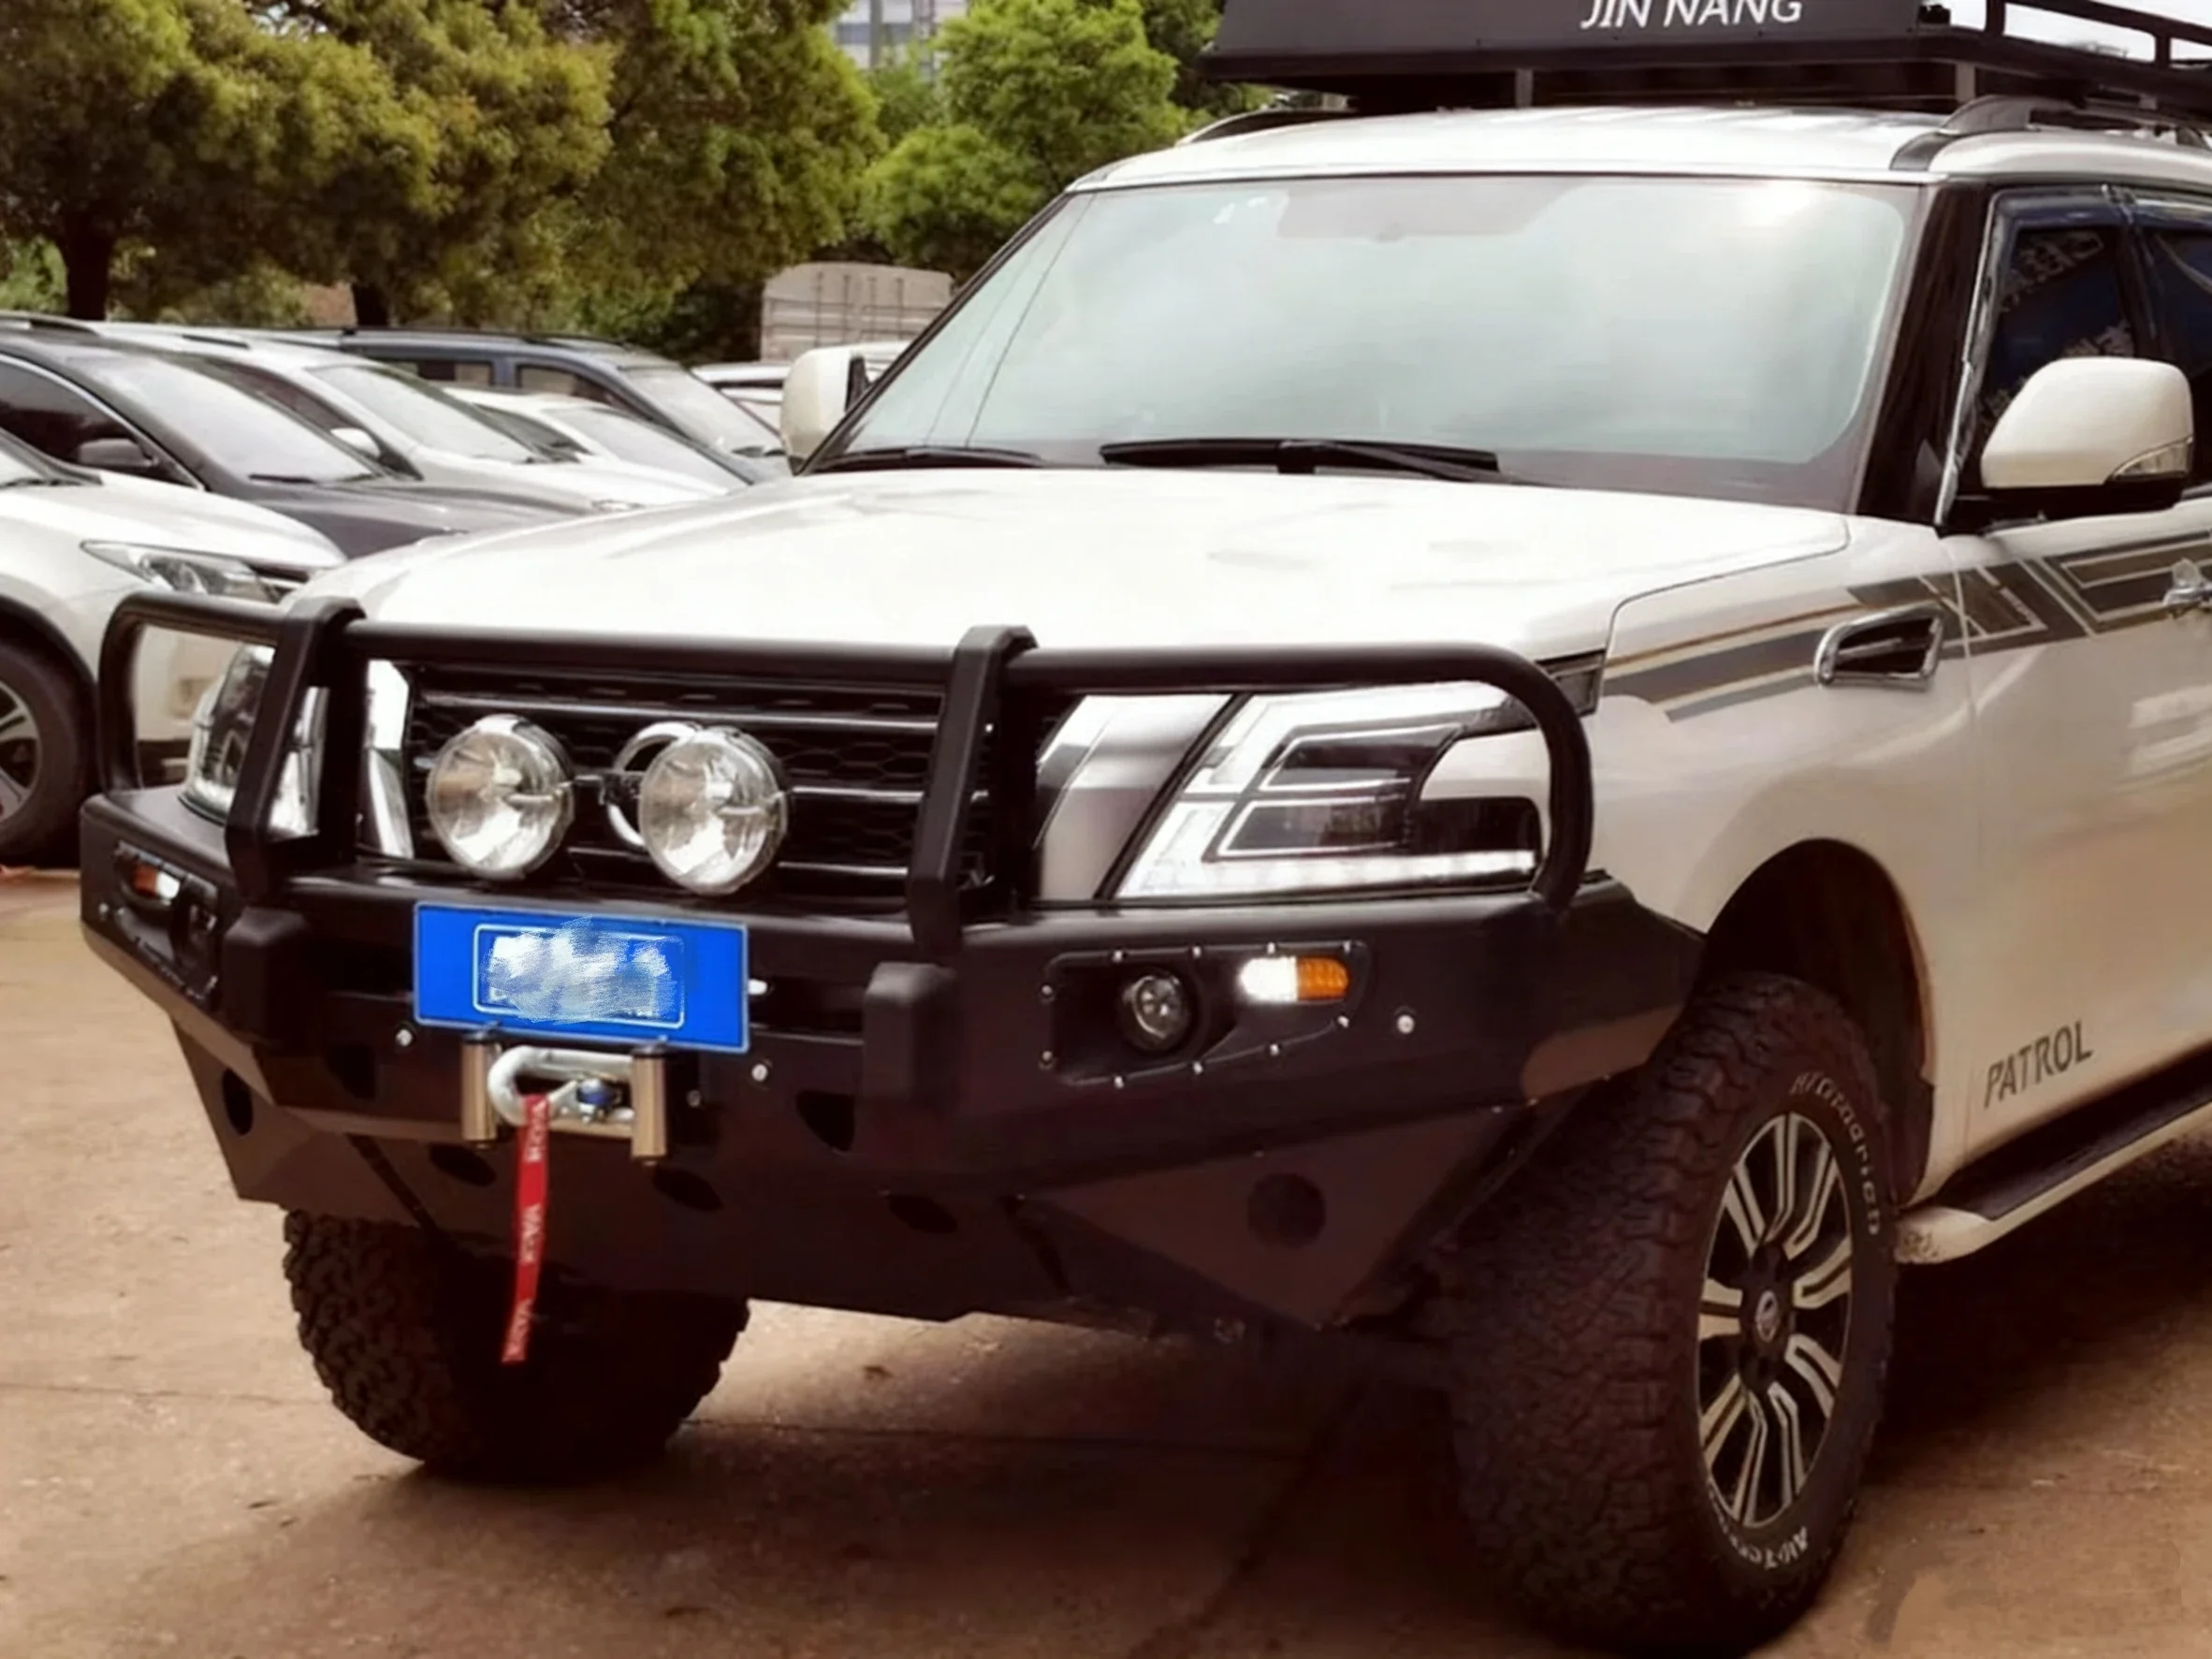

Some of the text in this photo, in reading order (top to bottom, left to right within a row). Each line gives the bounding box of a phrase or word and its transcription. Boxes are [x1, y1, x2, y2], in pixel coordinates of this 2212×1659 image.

[1579, 0, 1803, 29] JIN NANG
[1983, 1019, 2094, 1109] PATROL
